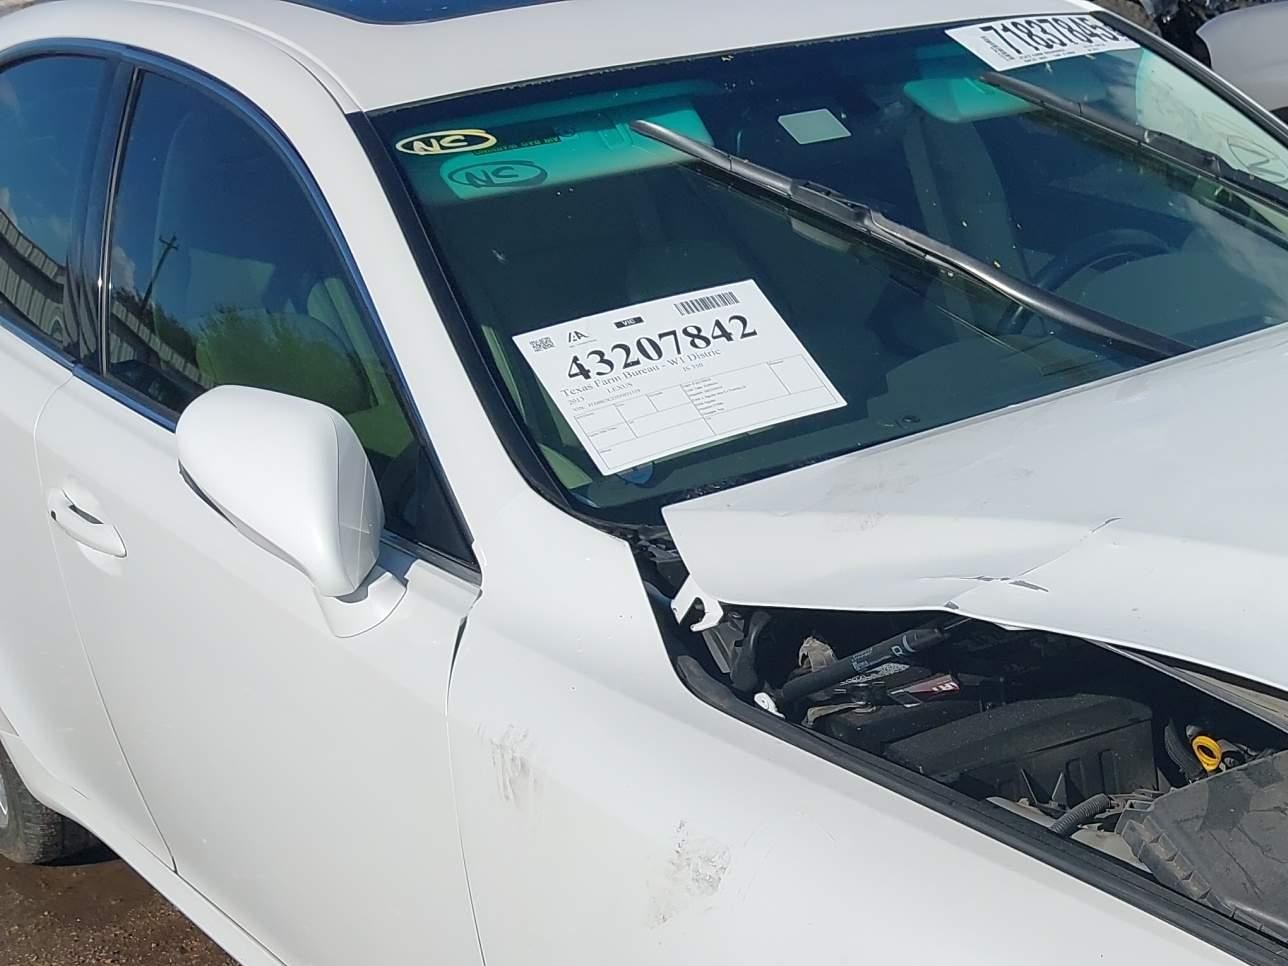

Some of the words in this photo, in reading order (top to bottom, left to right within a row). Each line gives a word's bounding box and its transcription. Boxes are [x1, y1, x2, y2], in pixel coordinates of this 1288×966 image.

[567, 314, 758, 381] 43207842
[559, 384, 594, 397] Texas
[593, 374, 622, 388] Farm
[622, 365, 660, 380] Bureau
